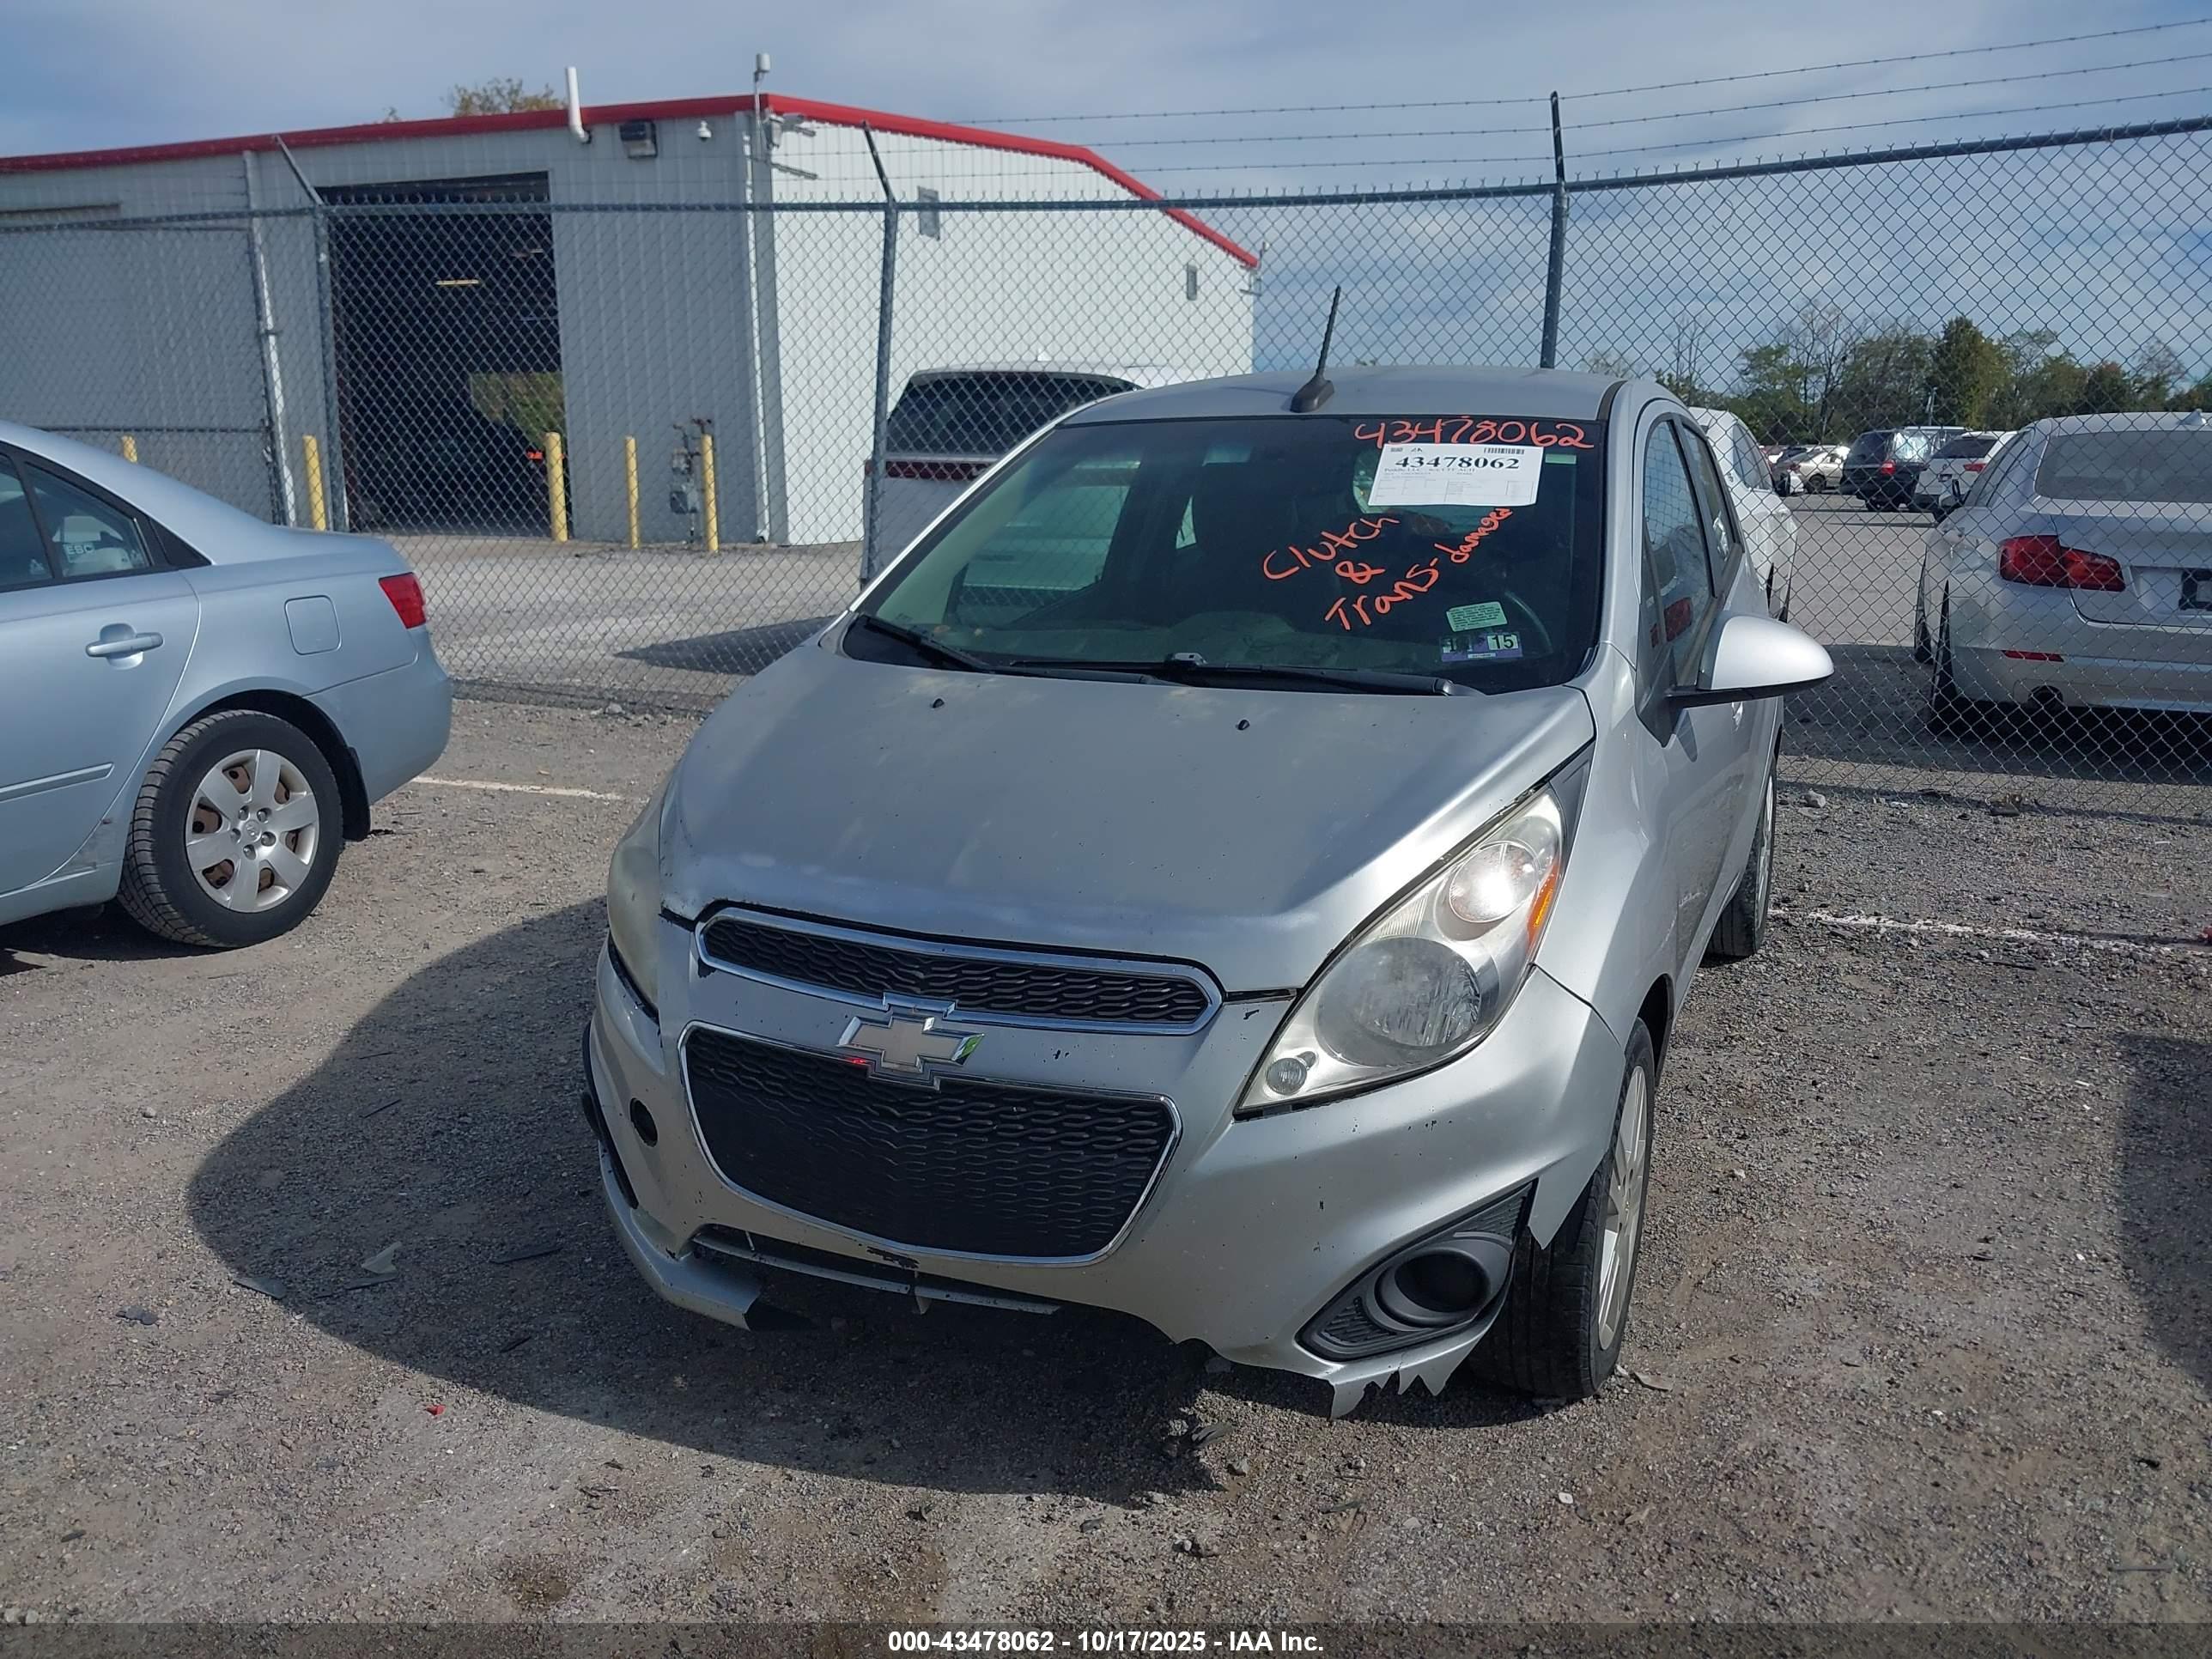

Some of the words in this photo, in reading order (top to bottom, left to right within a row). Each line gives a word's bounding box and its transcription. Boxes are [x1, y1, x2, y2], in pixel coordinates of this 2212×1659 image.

[1353, 416, 1594, 449] 43478062
[1395, 456, 1519, 470] 43478062
[1263, 517, 1401, 580] Clutch
[1334, 559, 1386, 585] &
[1492, 634, 1515, 648] 15
